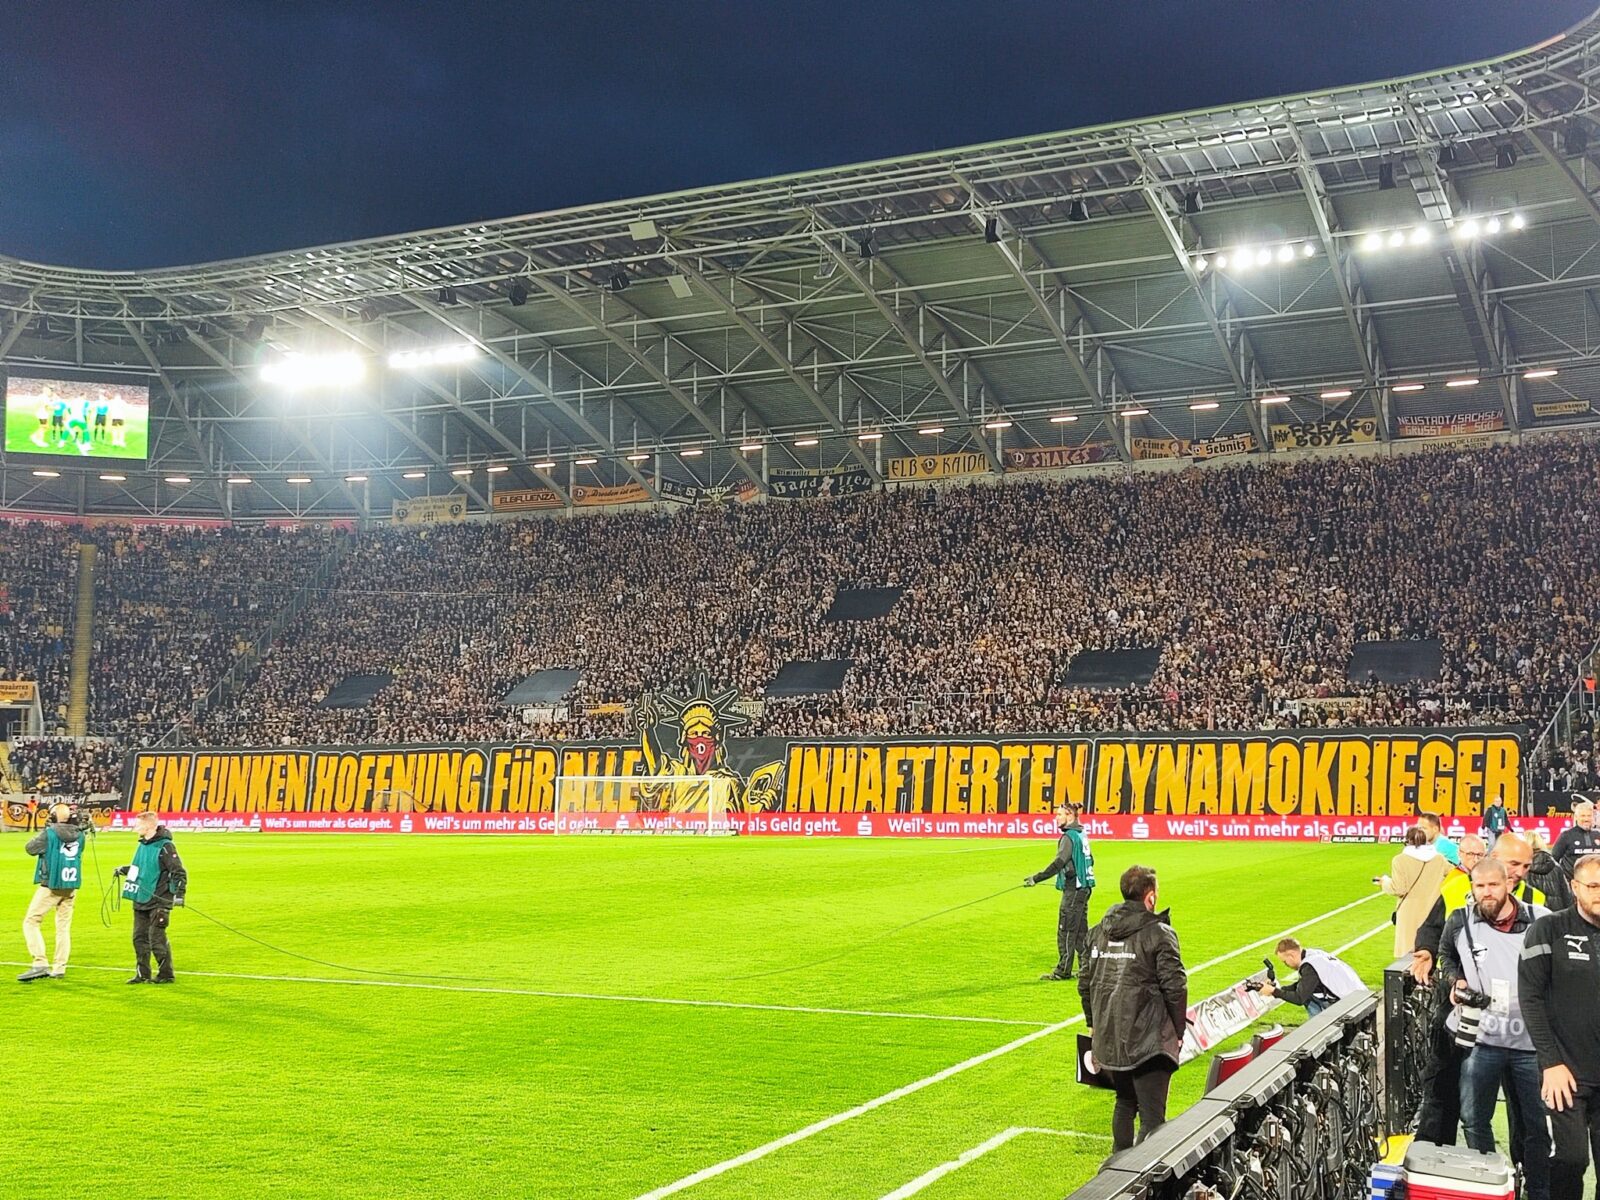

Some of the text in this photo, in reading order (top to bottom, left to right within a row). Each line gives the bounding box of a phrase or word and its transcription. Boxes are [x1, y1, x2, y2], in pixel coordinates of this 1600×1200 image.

[1289, 417, 1361, 437] FREAK
[1450, 424, 1467, 434] DIE
[1205, 441, 1246, 455] Sebnitz
[1422, 441, 1456, 452] DYNAMO
[1031, 447, 1089, 467] SNAKES
[891, 457, 917, 477] ELB
[663, 482, 697, 497] 19 53
[132, 756, 190, 812] EIN
[191, 754, 310, 812] FUNKEN
[313, 752, 483, 812] HOFFNUNG
[560, 749, 643, 813] ALLE
[785, 740, 1520, 817] INHAFTIERTEN DYNAMOKRIEGER
[265, 818, 393, 831] Weil's um mehr als Geld geht.
[425, 817, 460, 830] Weil's
[463, 820, 481, 830] um
[484, 817, 516, 830] mehr
[518, 817, 536, 830] als
[539, 817, 566, 831] Ged
[643, 817, 682, 830] Weil's
[686, 821, 707, 830] um
[748, 818, 767, 832] als
[770, 818, 801, 832] Geld
[805, 818, 841, 836] geht.
[888, 818, 1113, 835] Weil's um mehr als Gel eht.
[1167, 820, 1219, 836] Weil's
[1223, 823, 1250, 836] um
[1254, 819, 1301, 837] mehr
[1304, 821, 1332, 838] als
[1334, 822, 1374, 839] Geld
[62, 868, 77, 882] 02
